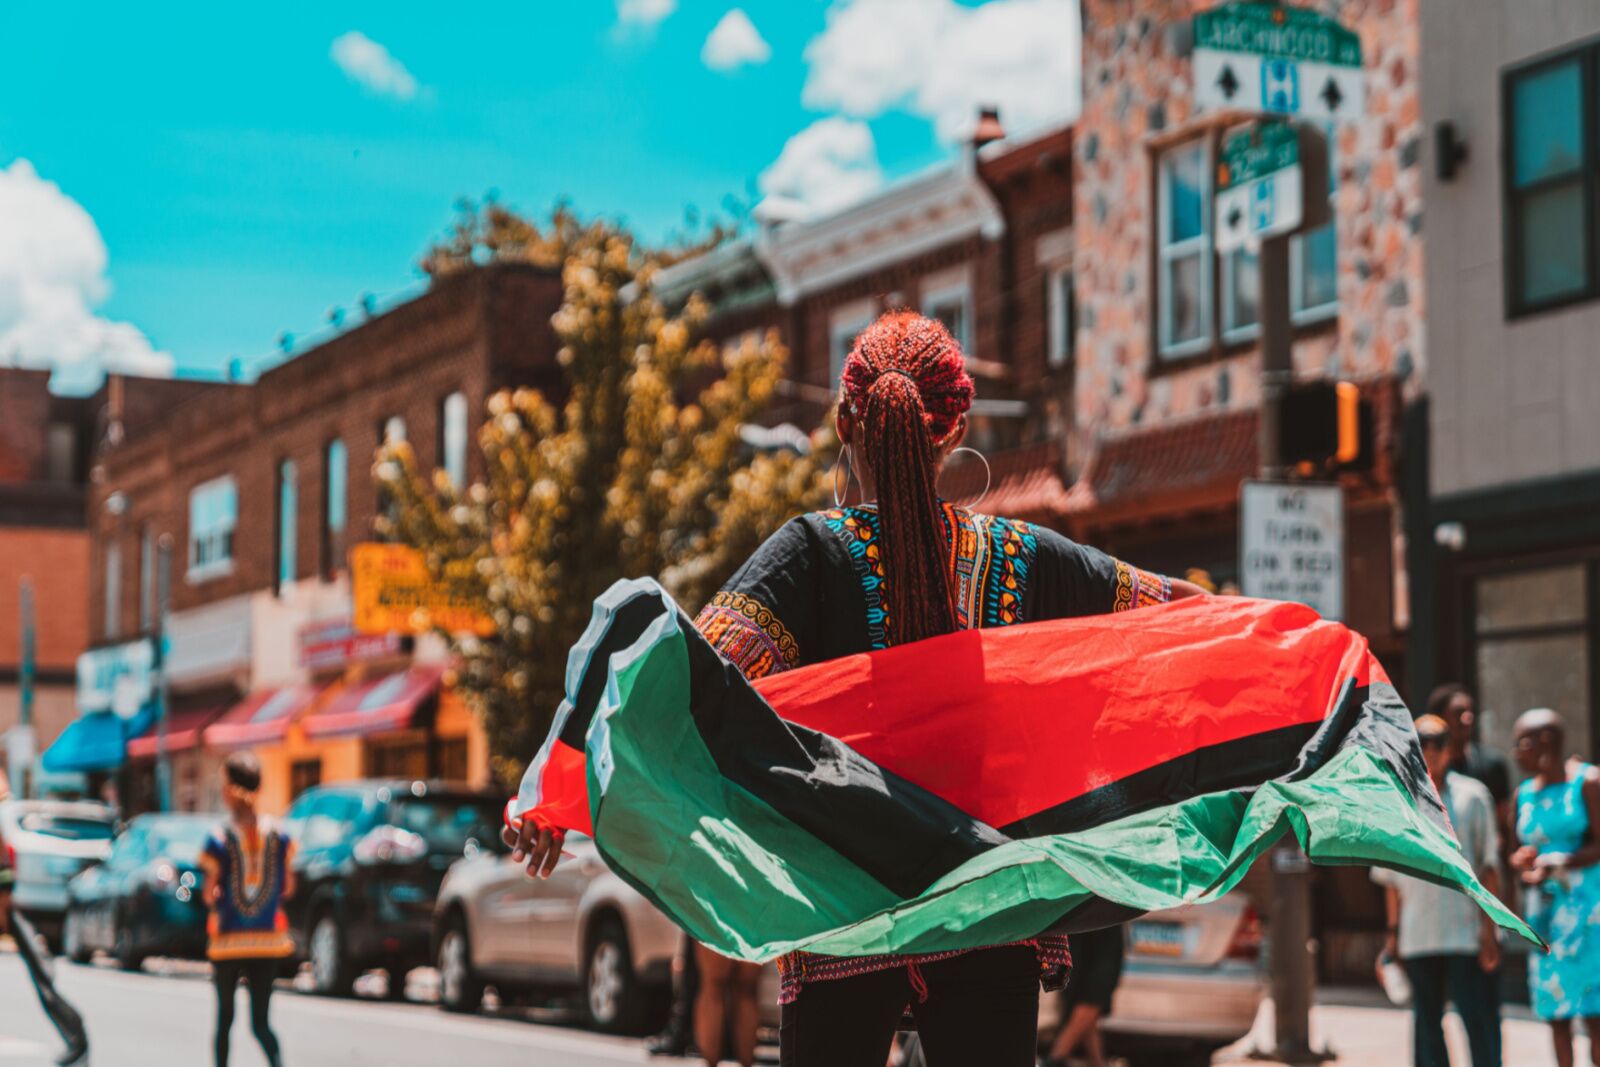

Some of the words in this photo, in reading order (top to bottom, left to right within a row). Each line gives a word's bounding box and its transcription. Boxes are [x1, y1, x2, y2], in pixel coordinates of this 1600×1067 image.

[1278, 488, 1306, 512] NO
[1264, 520, 1322, 544] TURN
[1246, 550, 1280, 574] ON
[1291, 552, 1334, 576] RED
